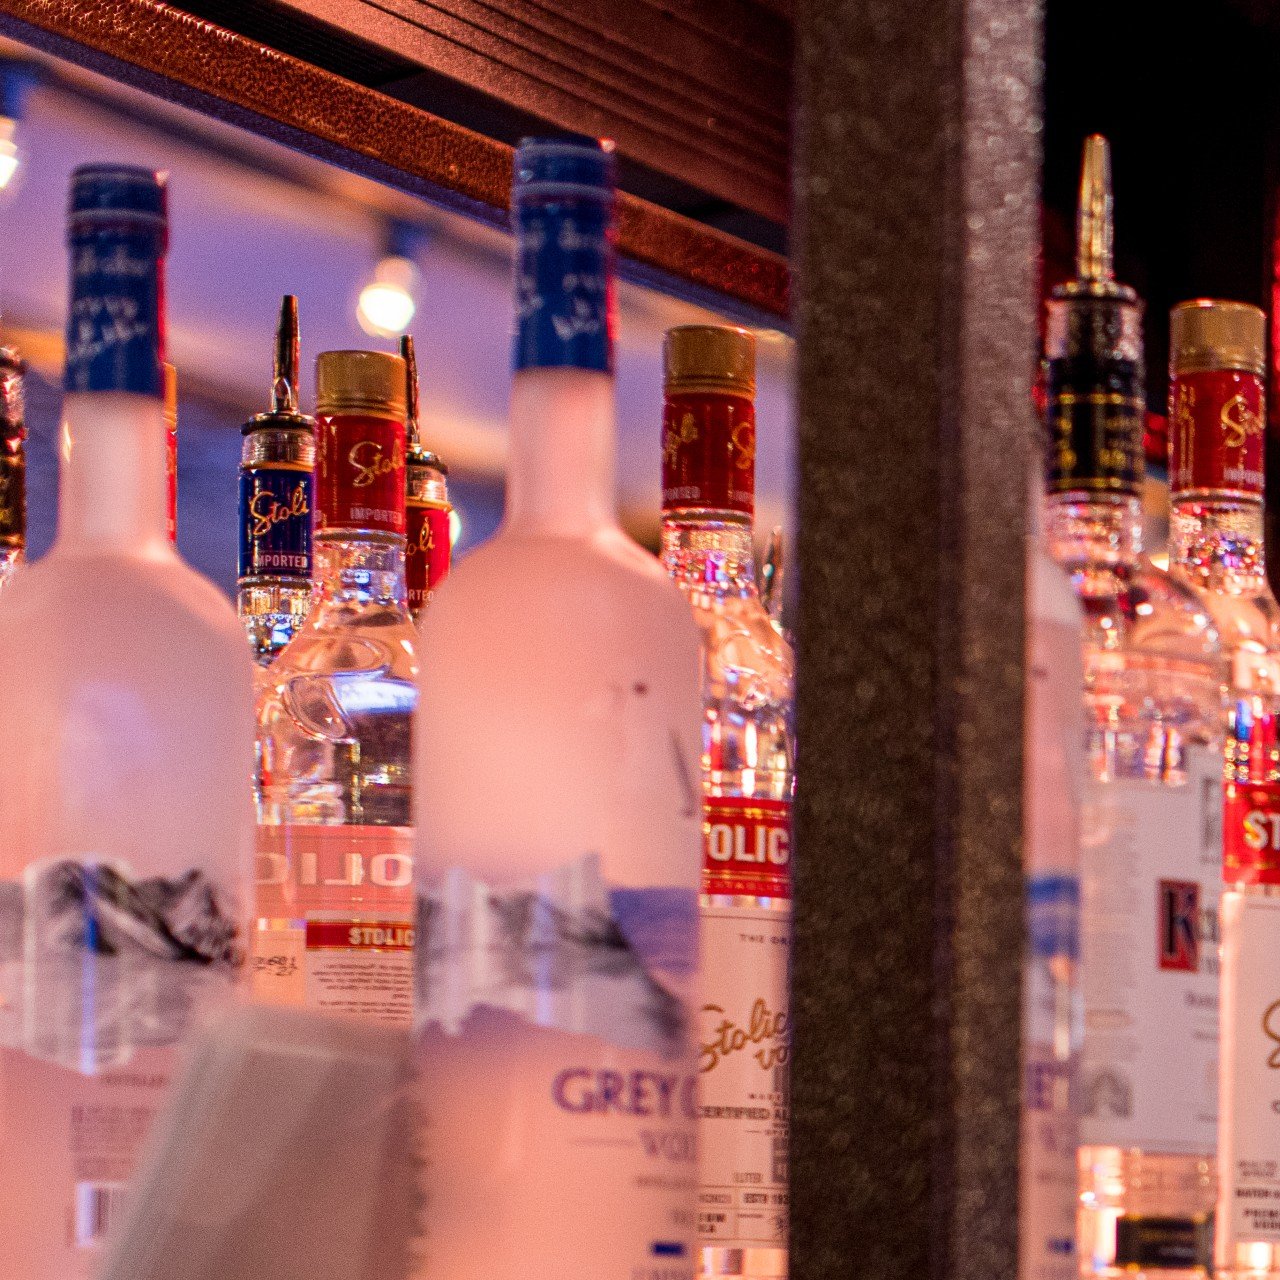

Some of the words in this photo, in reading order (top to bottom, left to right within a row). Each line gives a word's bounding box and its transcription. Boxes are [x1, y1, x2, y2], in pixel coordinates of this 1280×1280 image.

[249, 483, 309, 536] Stoli
[254, 553, 309, 569] IMPORTED
[552, 1067, 678, 1117] GREY
